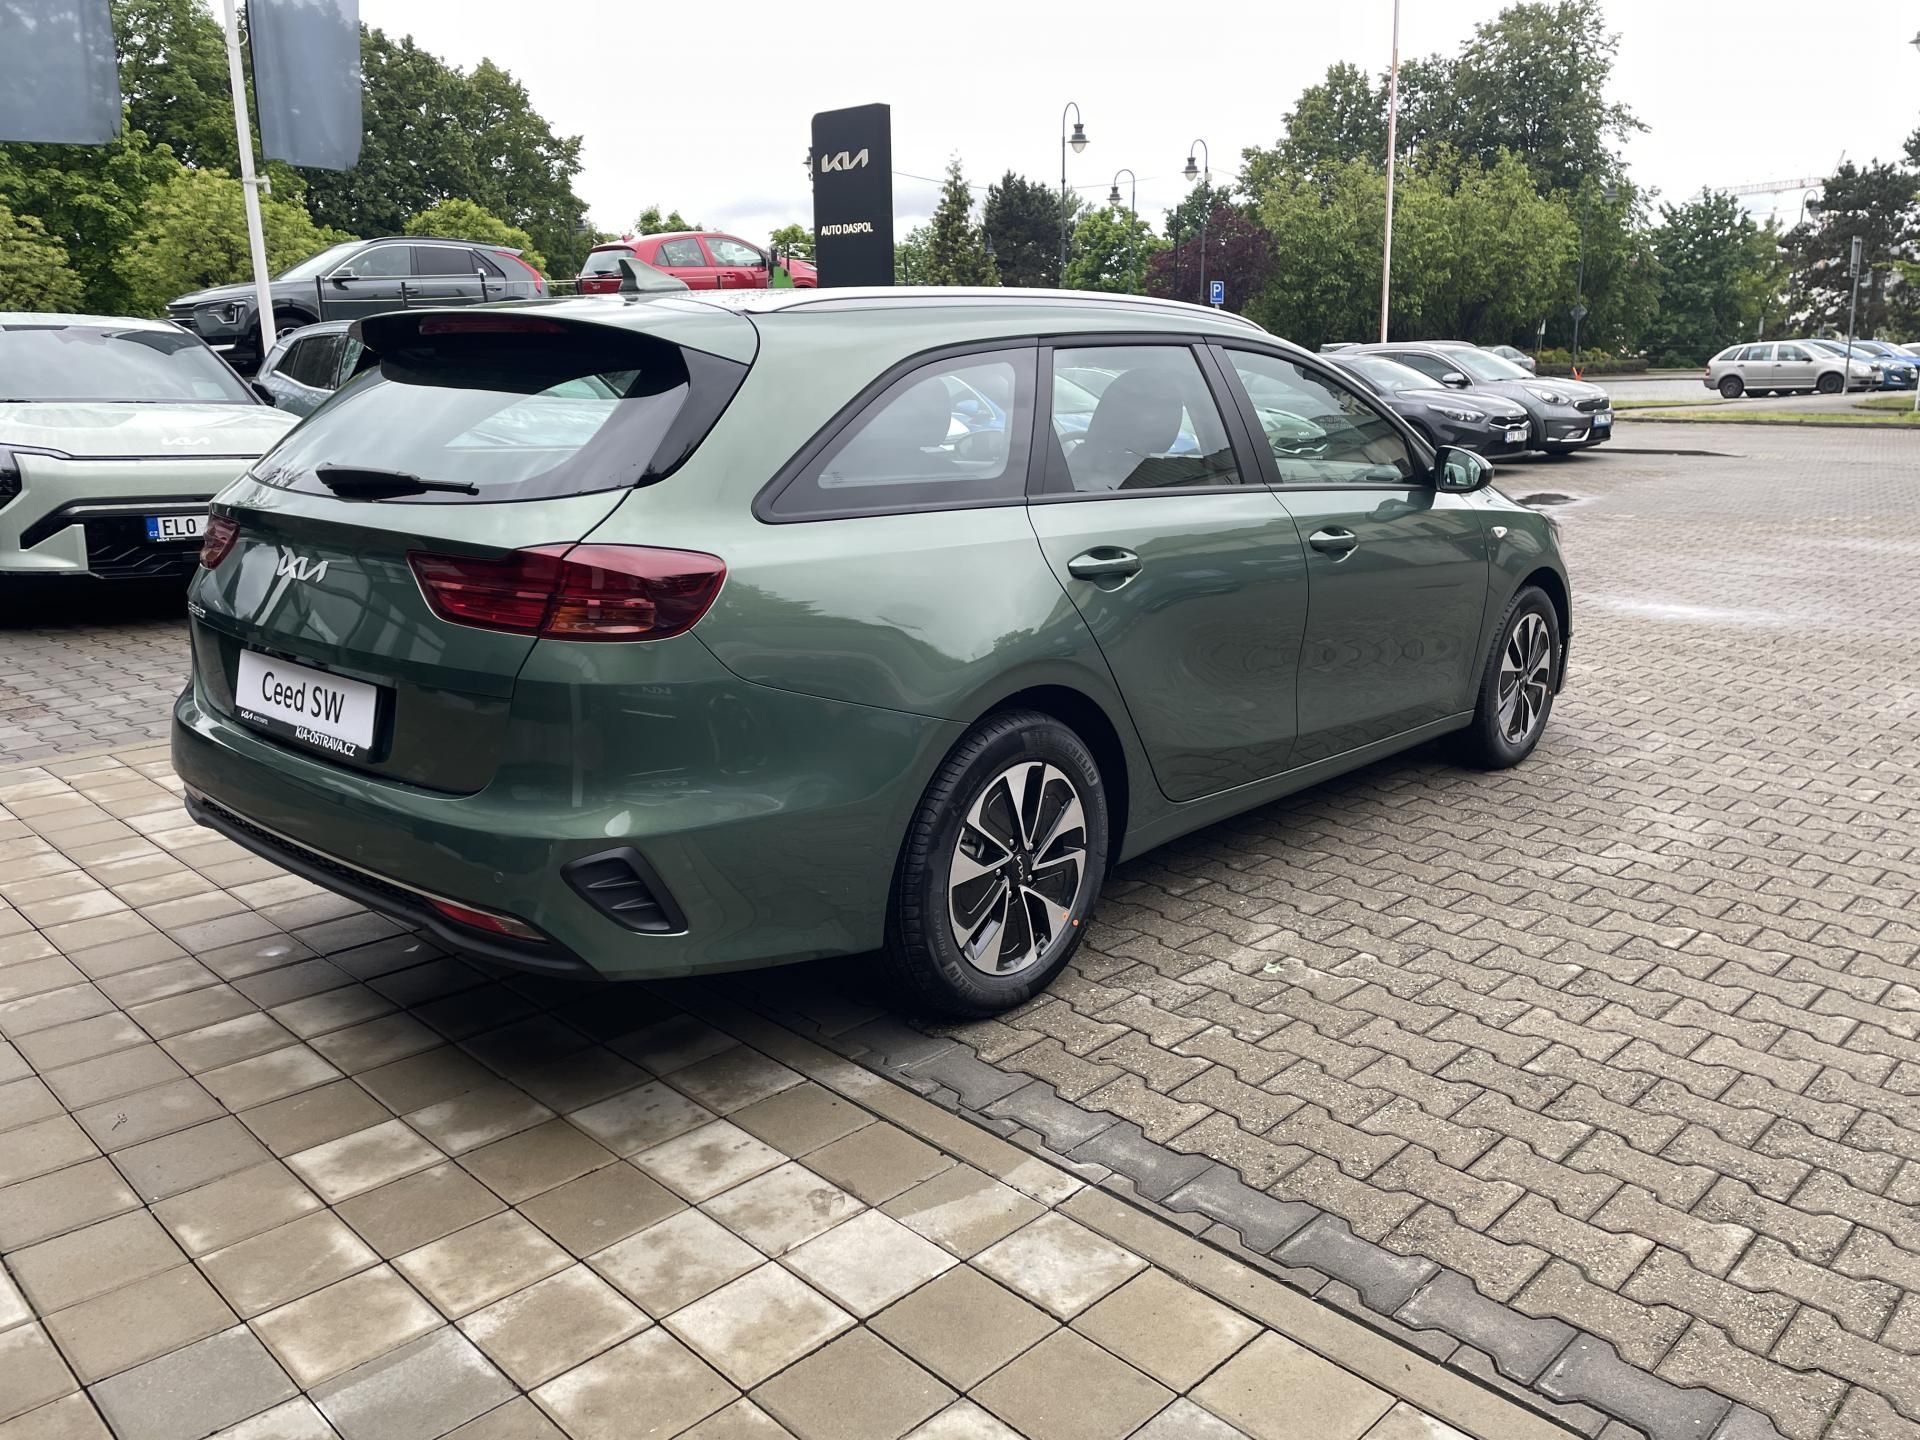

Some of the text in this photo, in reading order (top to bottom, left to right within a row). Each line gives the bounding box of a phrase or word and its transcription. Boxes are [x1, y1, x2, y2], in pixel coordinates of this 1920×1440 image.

[821, 148, 869, 173] KIA
[820, 221, 873, 236] AUTO DASPOL
[1213, 284, 1221, 297] P
[276, 553, 329, 583] KIA
[262, 671, 345, 724] Ceed SW
[295, 725, 356, 757] KIA-OSTRAVA.CZ
